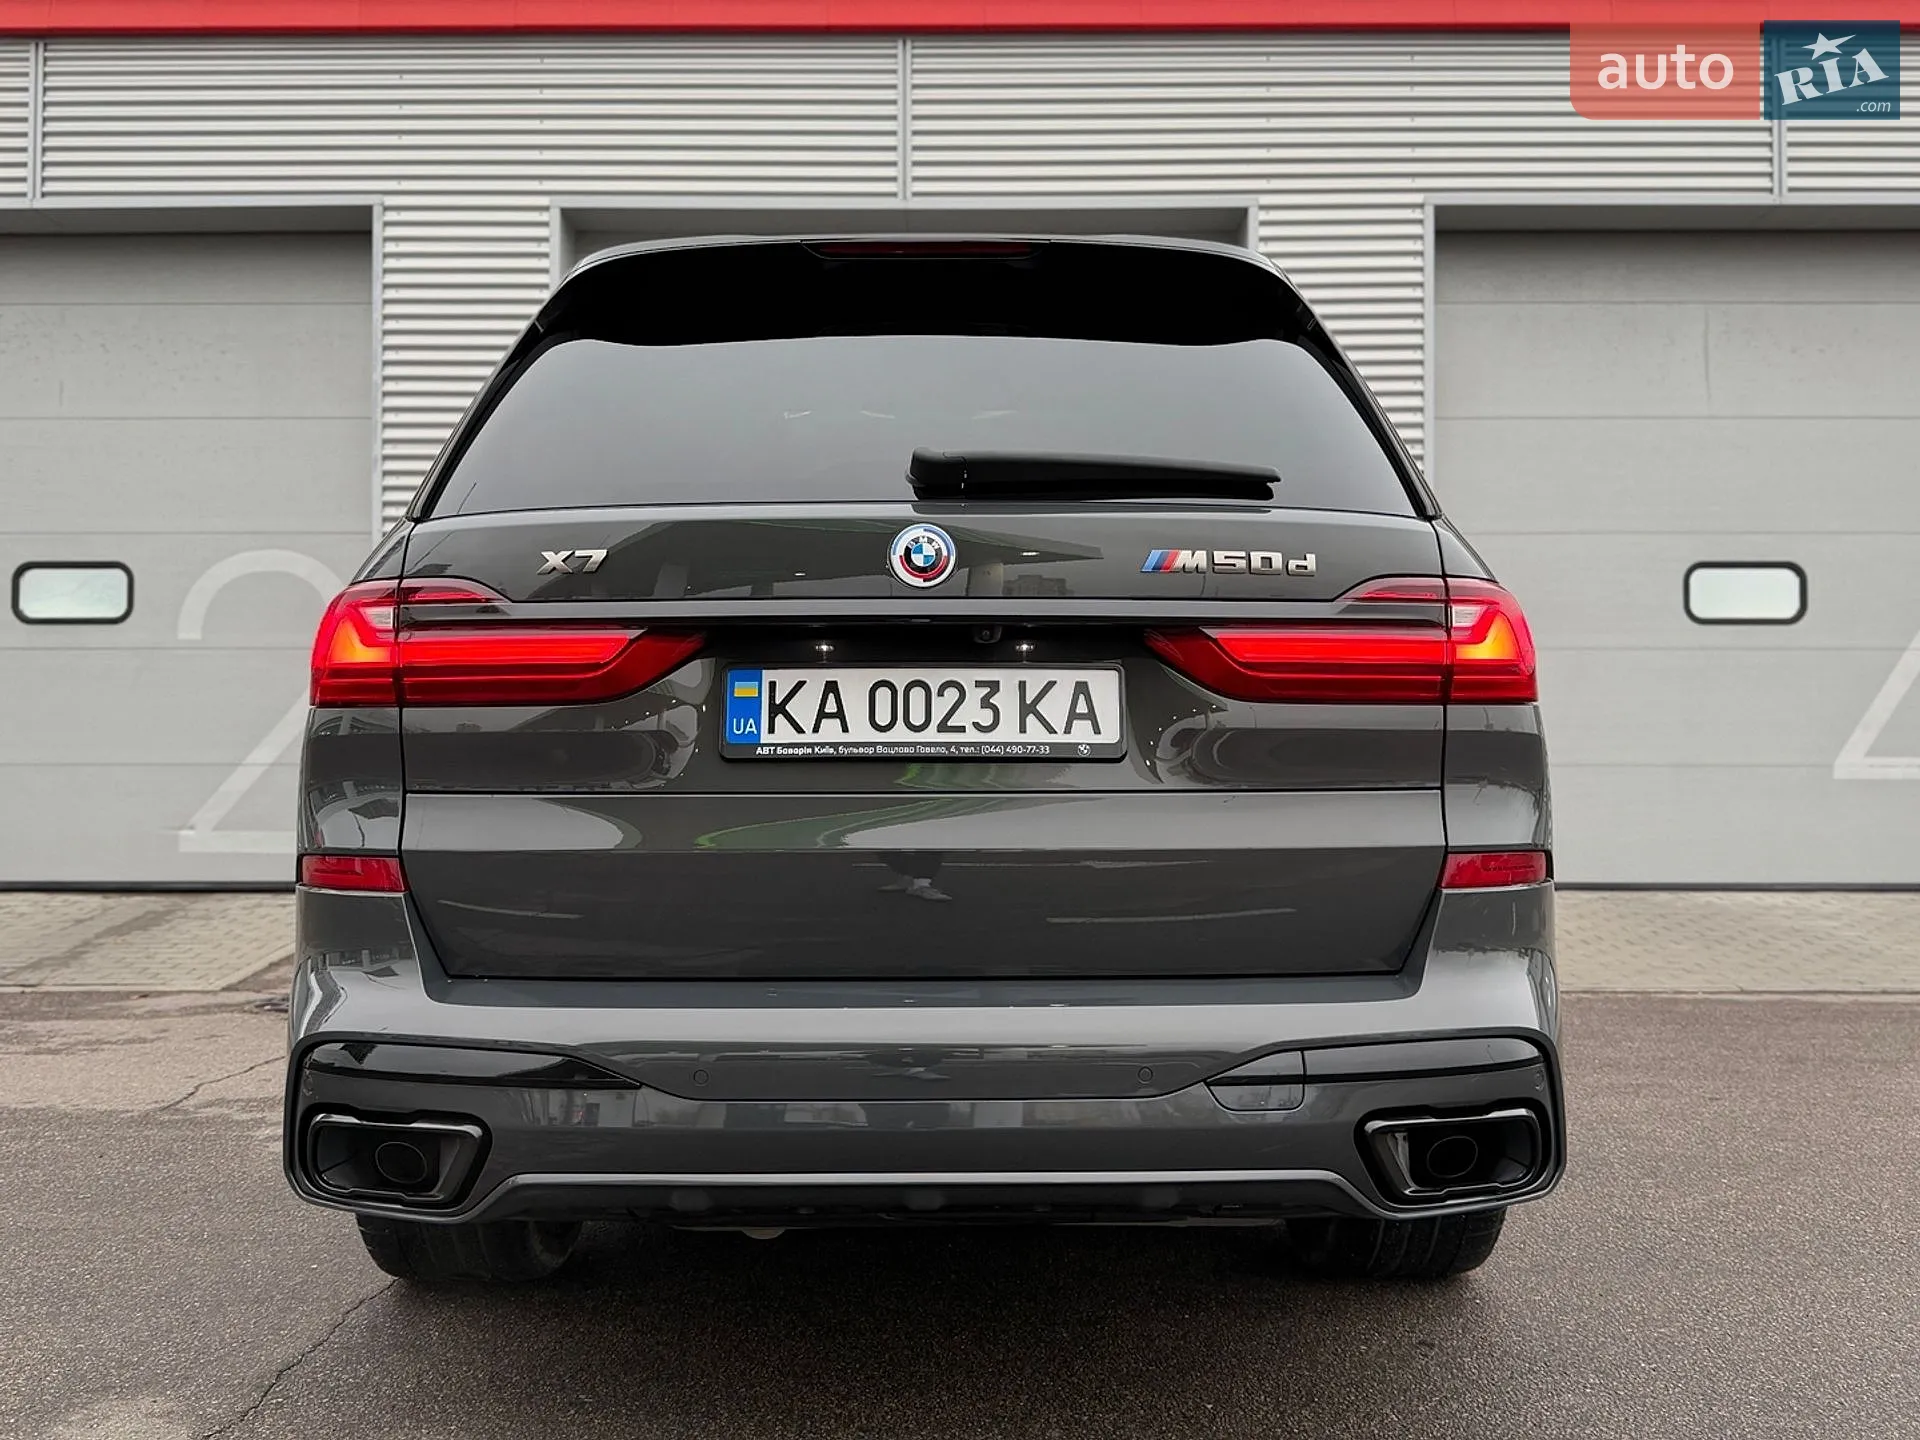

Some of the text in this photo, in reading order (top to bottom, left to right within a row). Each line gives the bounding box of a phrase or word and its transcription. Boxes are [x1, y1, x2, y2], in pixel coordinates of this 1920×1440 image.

[536, 549, 608, 575] X7
[1170, 549, 1317, 577] M50d
[766, 679, 1102, 735] KA 0023 KA
[733, 718, 758, 735] UA
[756, 746, 775, 755] АВТ
[981, 745, 1004, 755] (044)
[1006, 745, 1050, 754] 490-77-33
